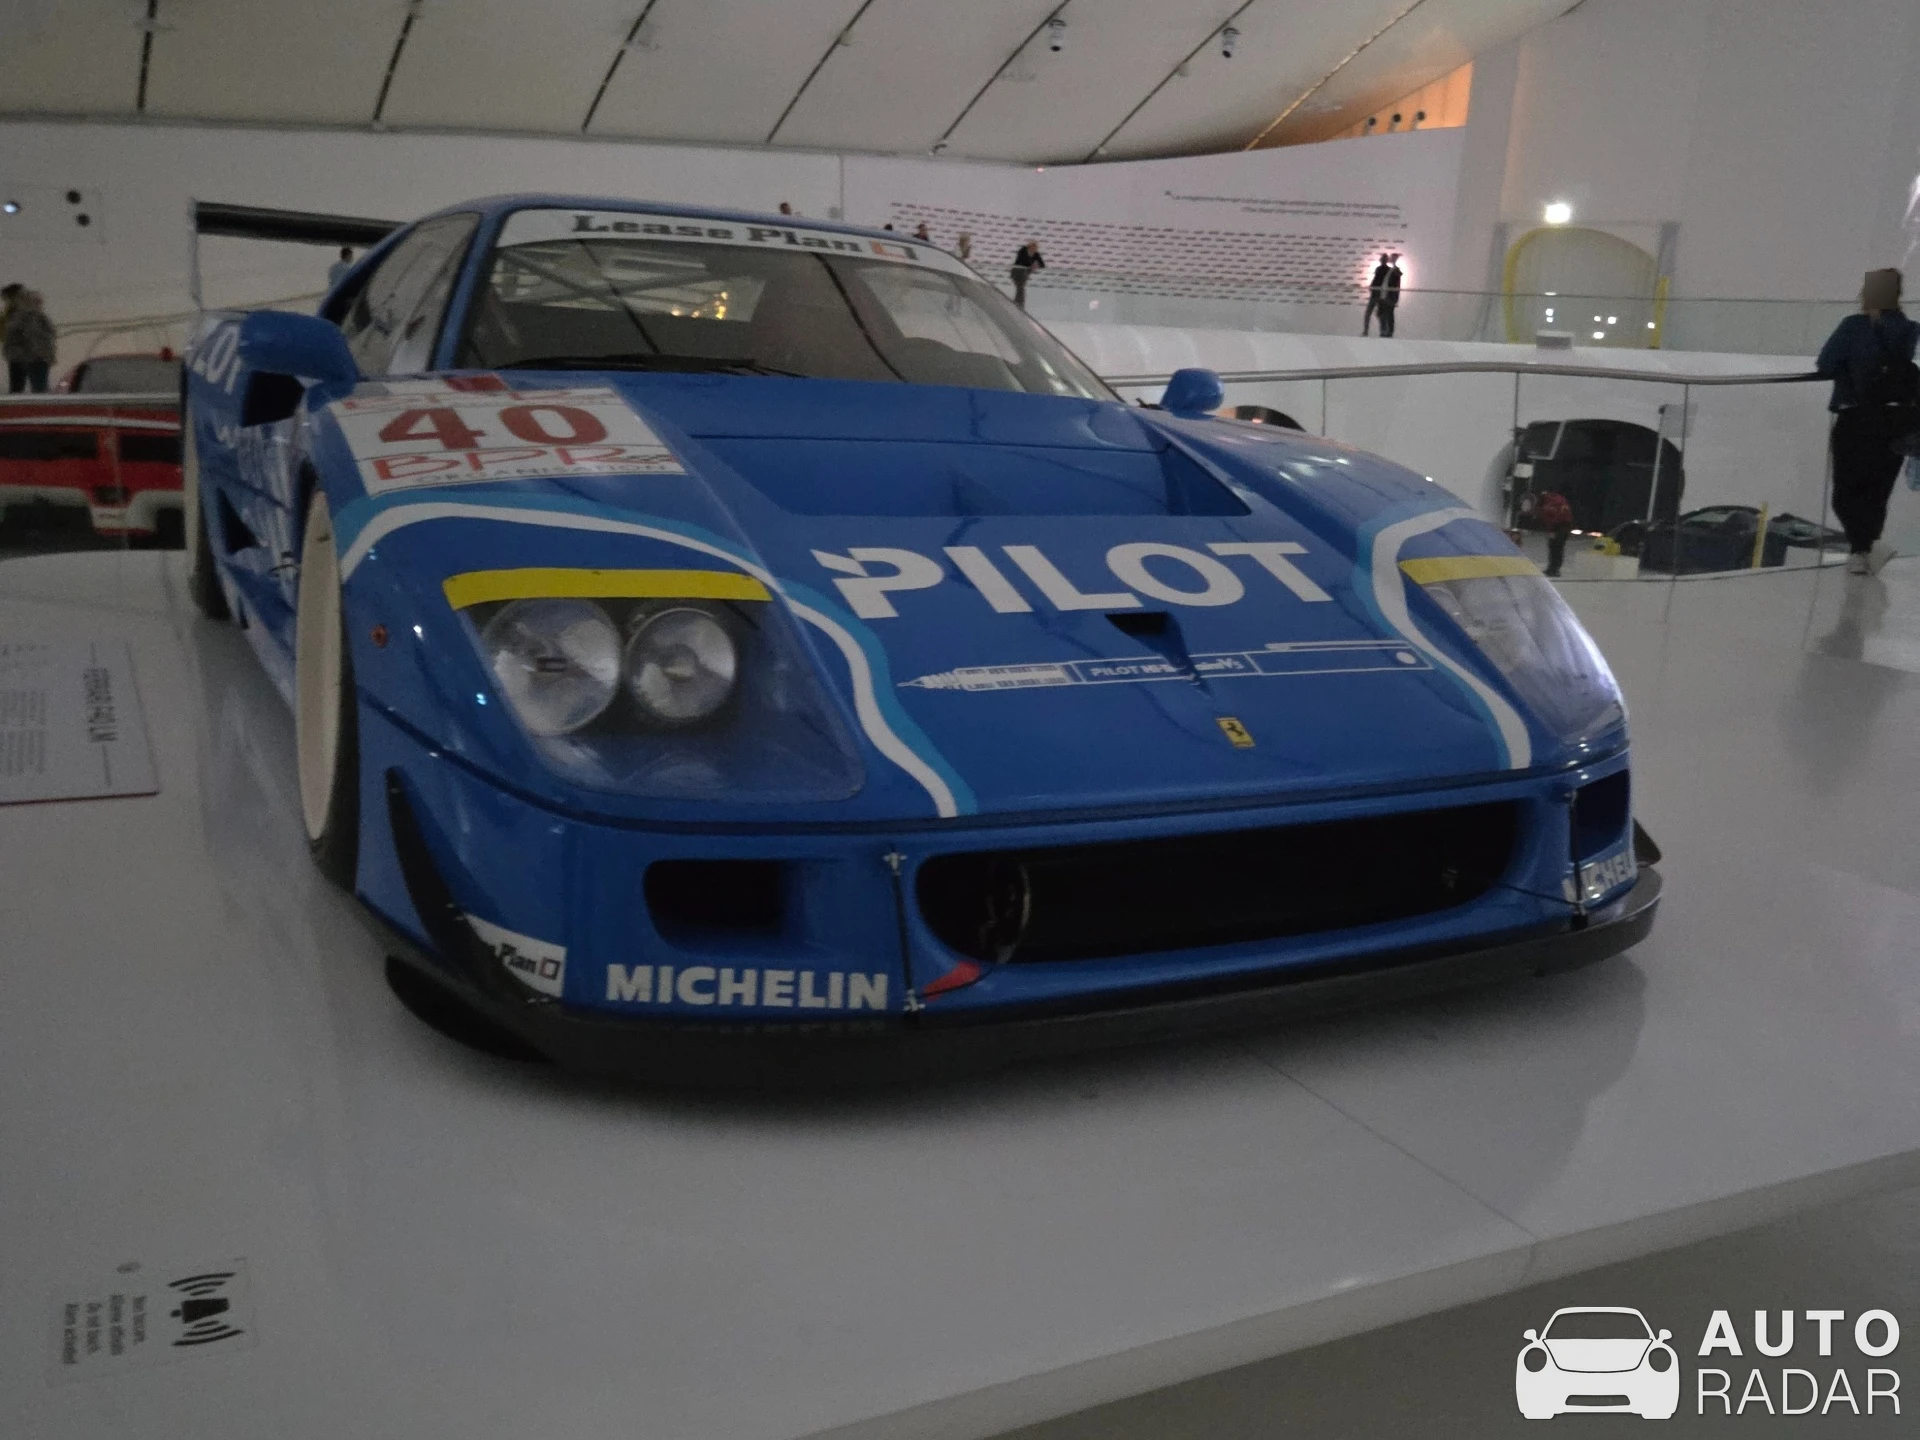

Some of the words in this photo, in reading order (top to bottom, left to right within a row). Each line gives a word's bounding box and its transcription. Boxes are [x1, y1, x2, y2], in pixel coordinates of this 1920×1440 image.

[572, 215, 734, 240] Lease
[747, 226, 862, 253] Plan
[378, 404, 609, 451] 40
[373, 447, 679, 481] BPR
[810, 542, 1334, 618] PILOT
[1090, 665, 1139, 676] PILOT
[606, 963, 889, 1010] MICHELIN
